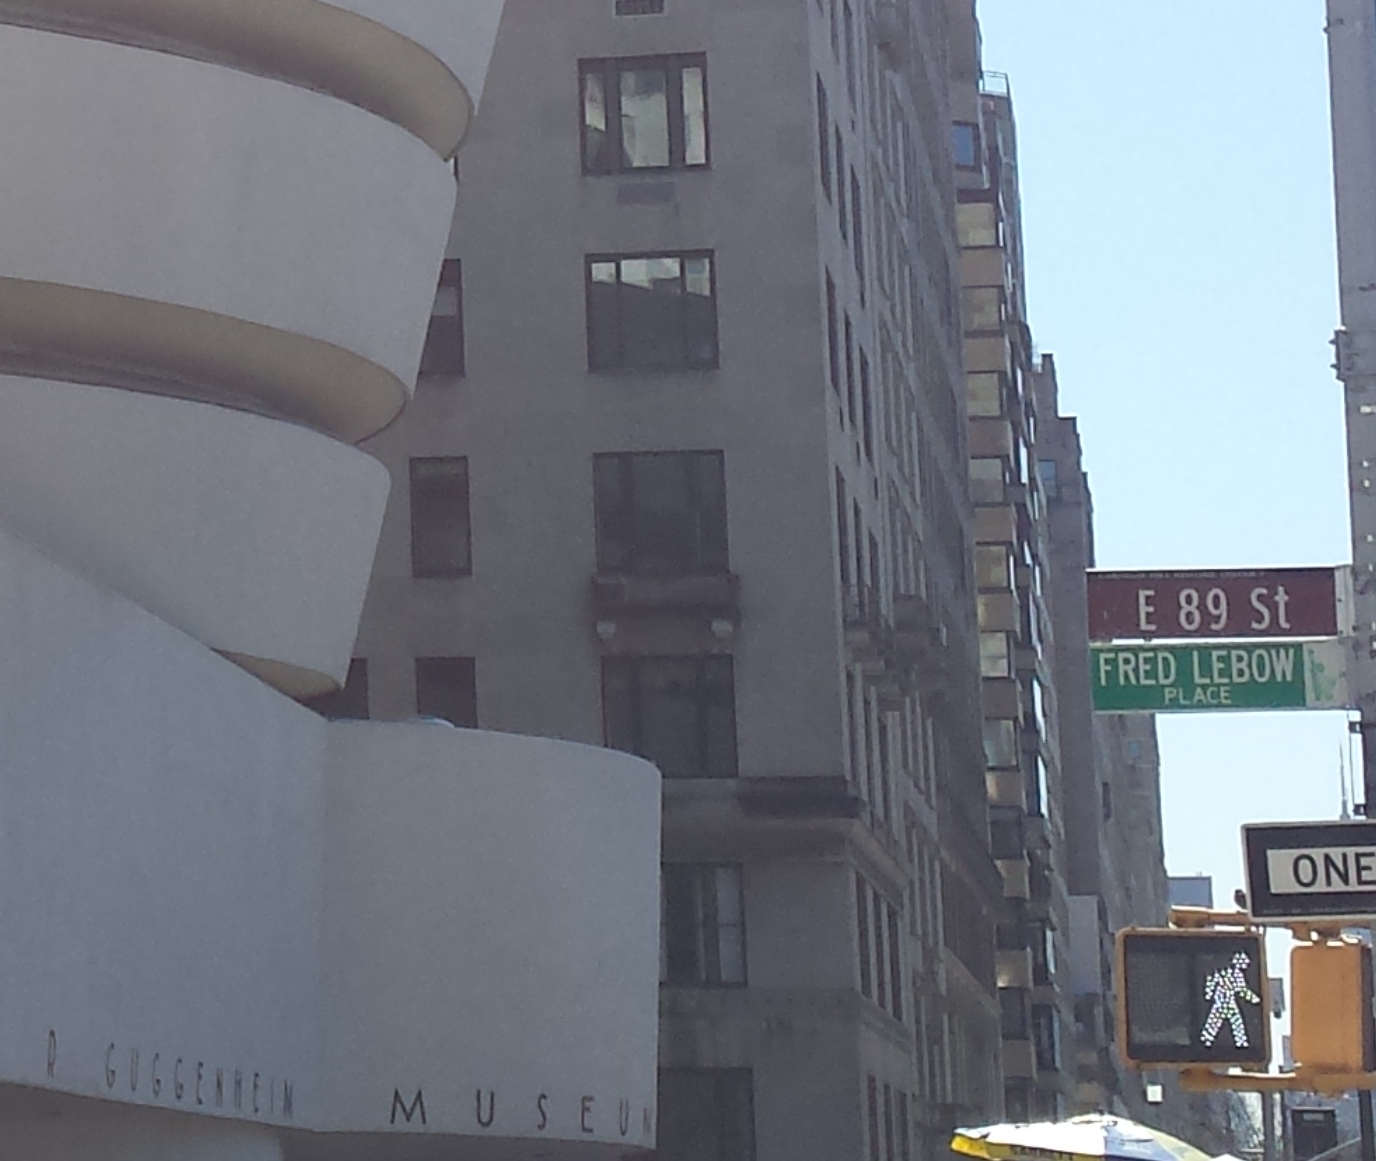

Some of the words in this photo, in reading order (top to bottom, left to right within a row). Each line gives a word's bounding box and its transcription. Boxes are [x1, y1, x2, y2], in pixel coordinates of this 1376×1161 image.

[1137, 588, 1157, 631] E
[1178, 588, 1229, 631] 89
[1249, 585, 1291, 630] St
[1098, 651, 1176, 686] FRED
[1192, 647, 1295, 684] LEBOW
[1164, 686, 1232, 705] PLACE
[1292, 851, 1376, 888] ONE
[47, 1029, 57, 1079] R
[105, 1042, 294, 1118] GUGGENHEIM
